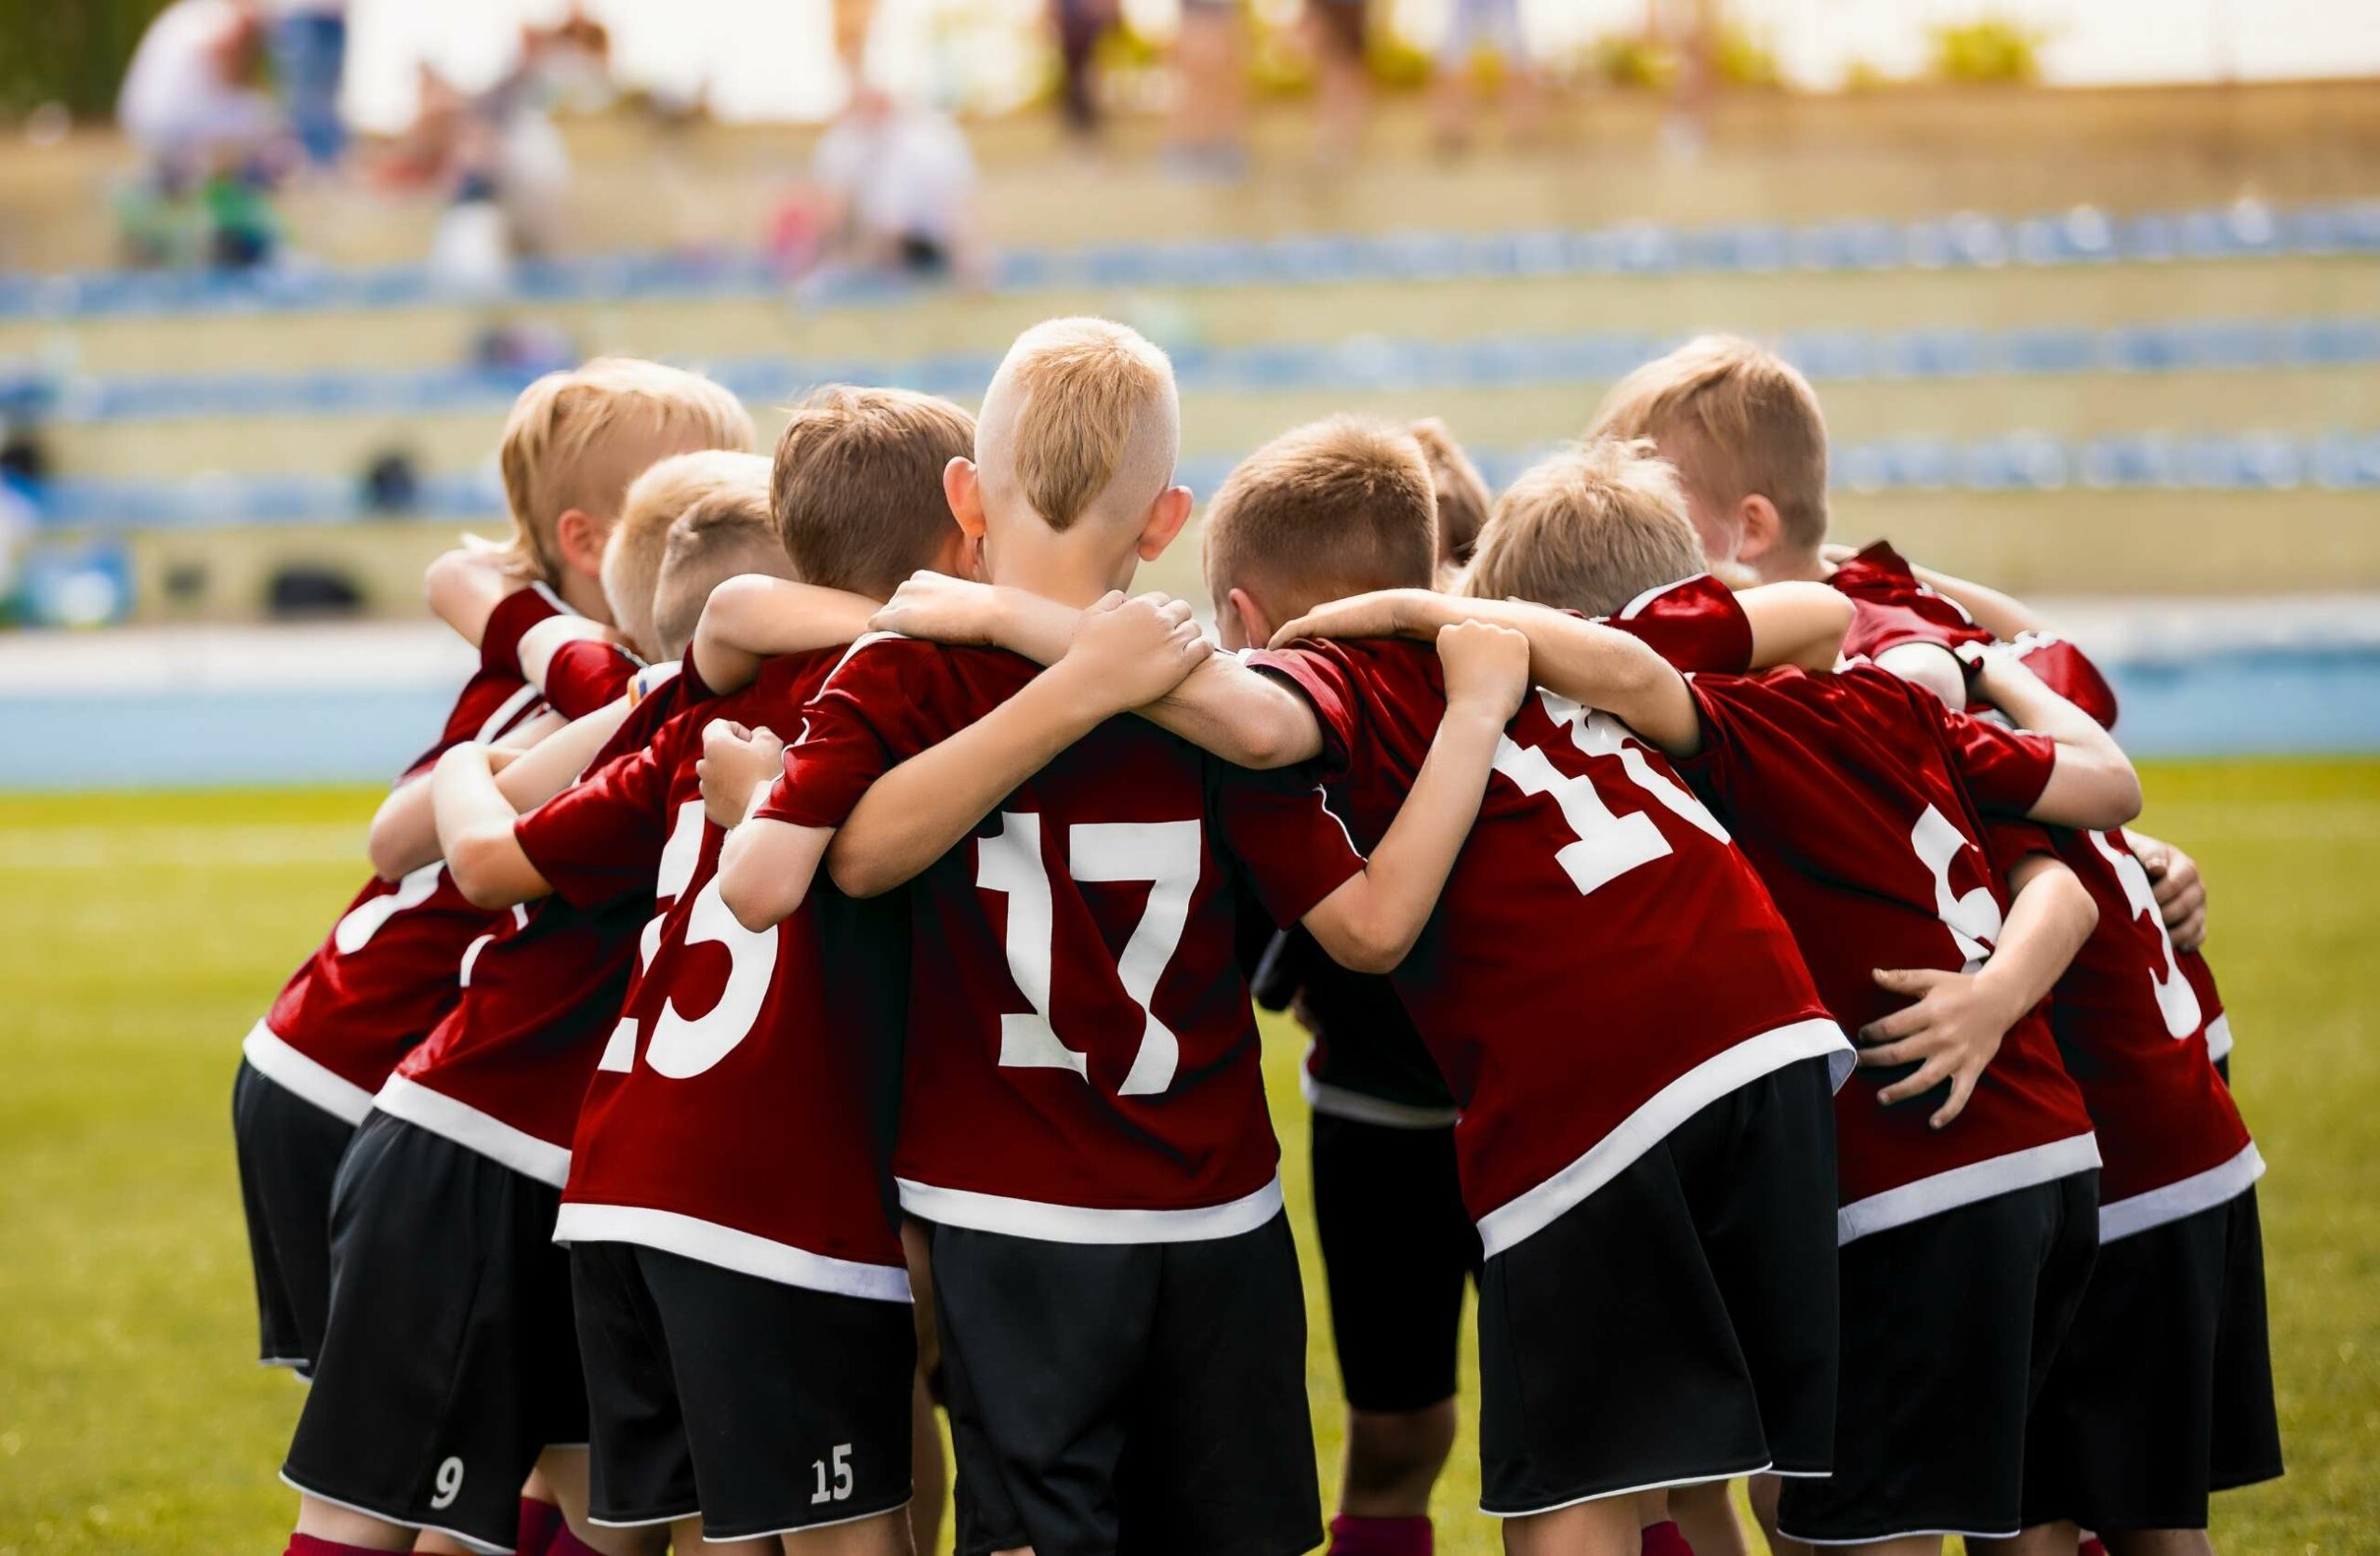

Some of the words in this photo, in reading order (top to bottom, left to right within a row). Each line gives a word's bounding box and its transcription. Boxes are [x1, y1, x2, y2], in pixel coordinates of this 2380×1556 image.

[975, 811, 1201, 1097] 17
[430, 1457, 464, 1510] 9
[811, 1444, 853, 1504] 15
